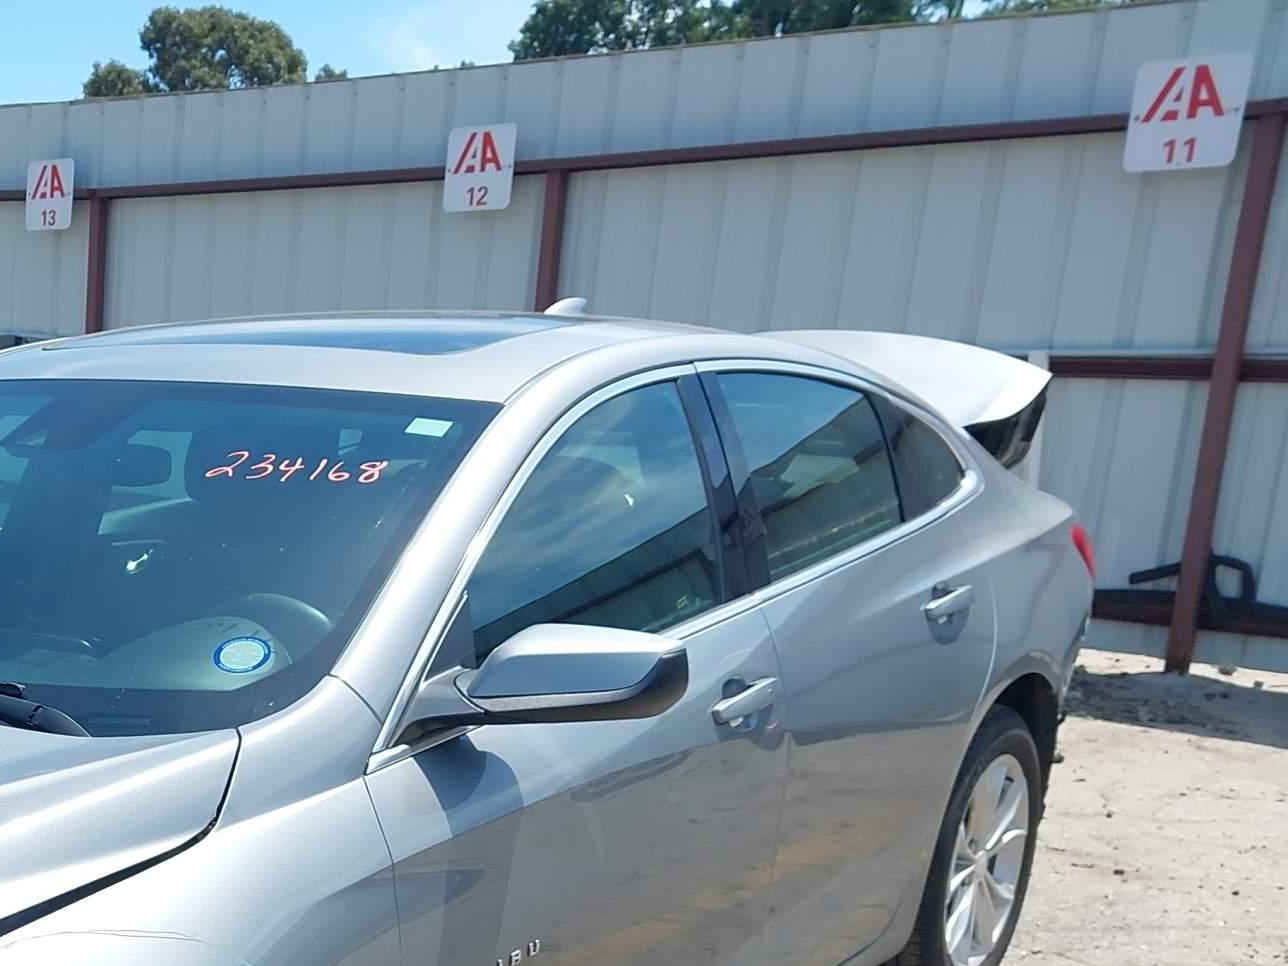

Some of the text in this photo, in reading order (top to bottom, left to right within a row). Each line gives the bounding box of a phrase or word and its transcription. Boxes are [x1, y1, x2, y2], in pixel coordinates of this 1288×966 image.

[1163, 137, 1196, 164] 11
[466, 186, 488, 206] 12
[41, 209, 56, 226] 13
[205, 450, 388, 483] 234168
